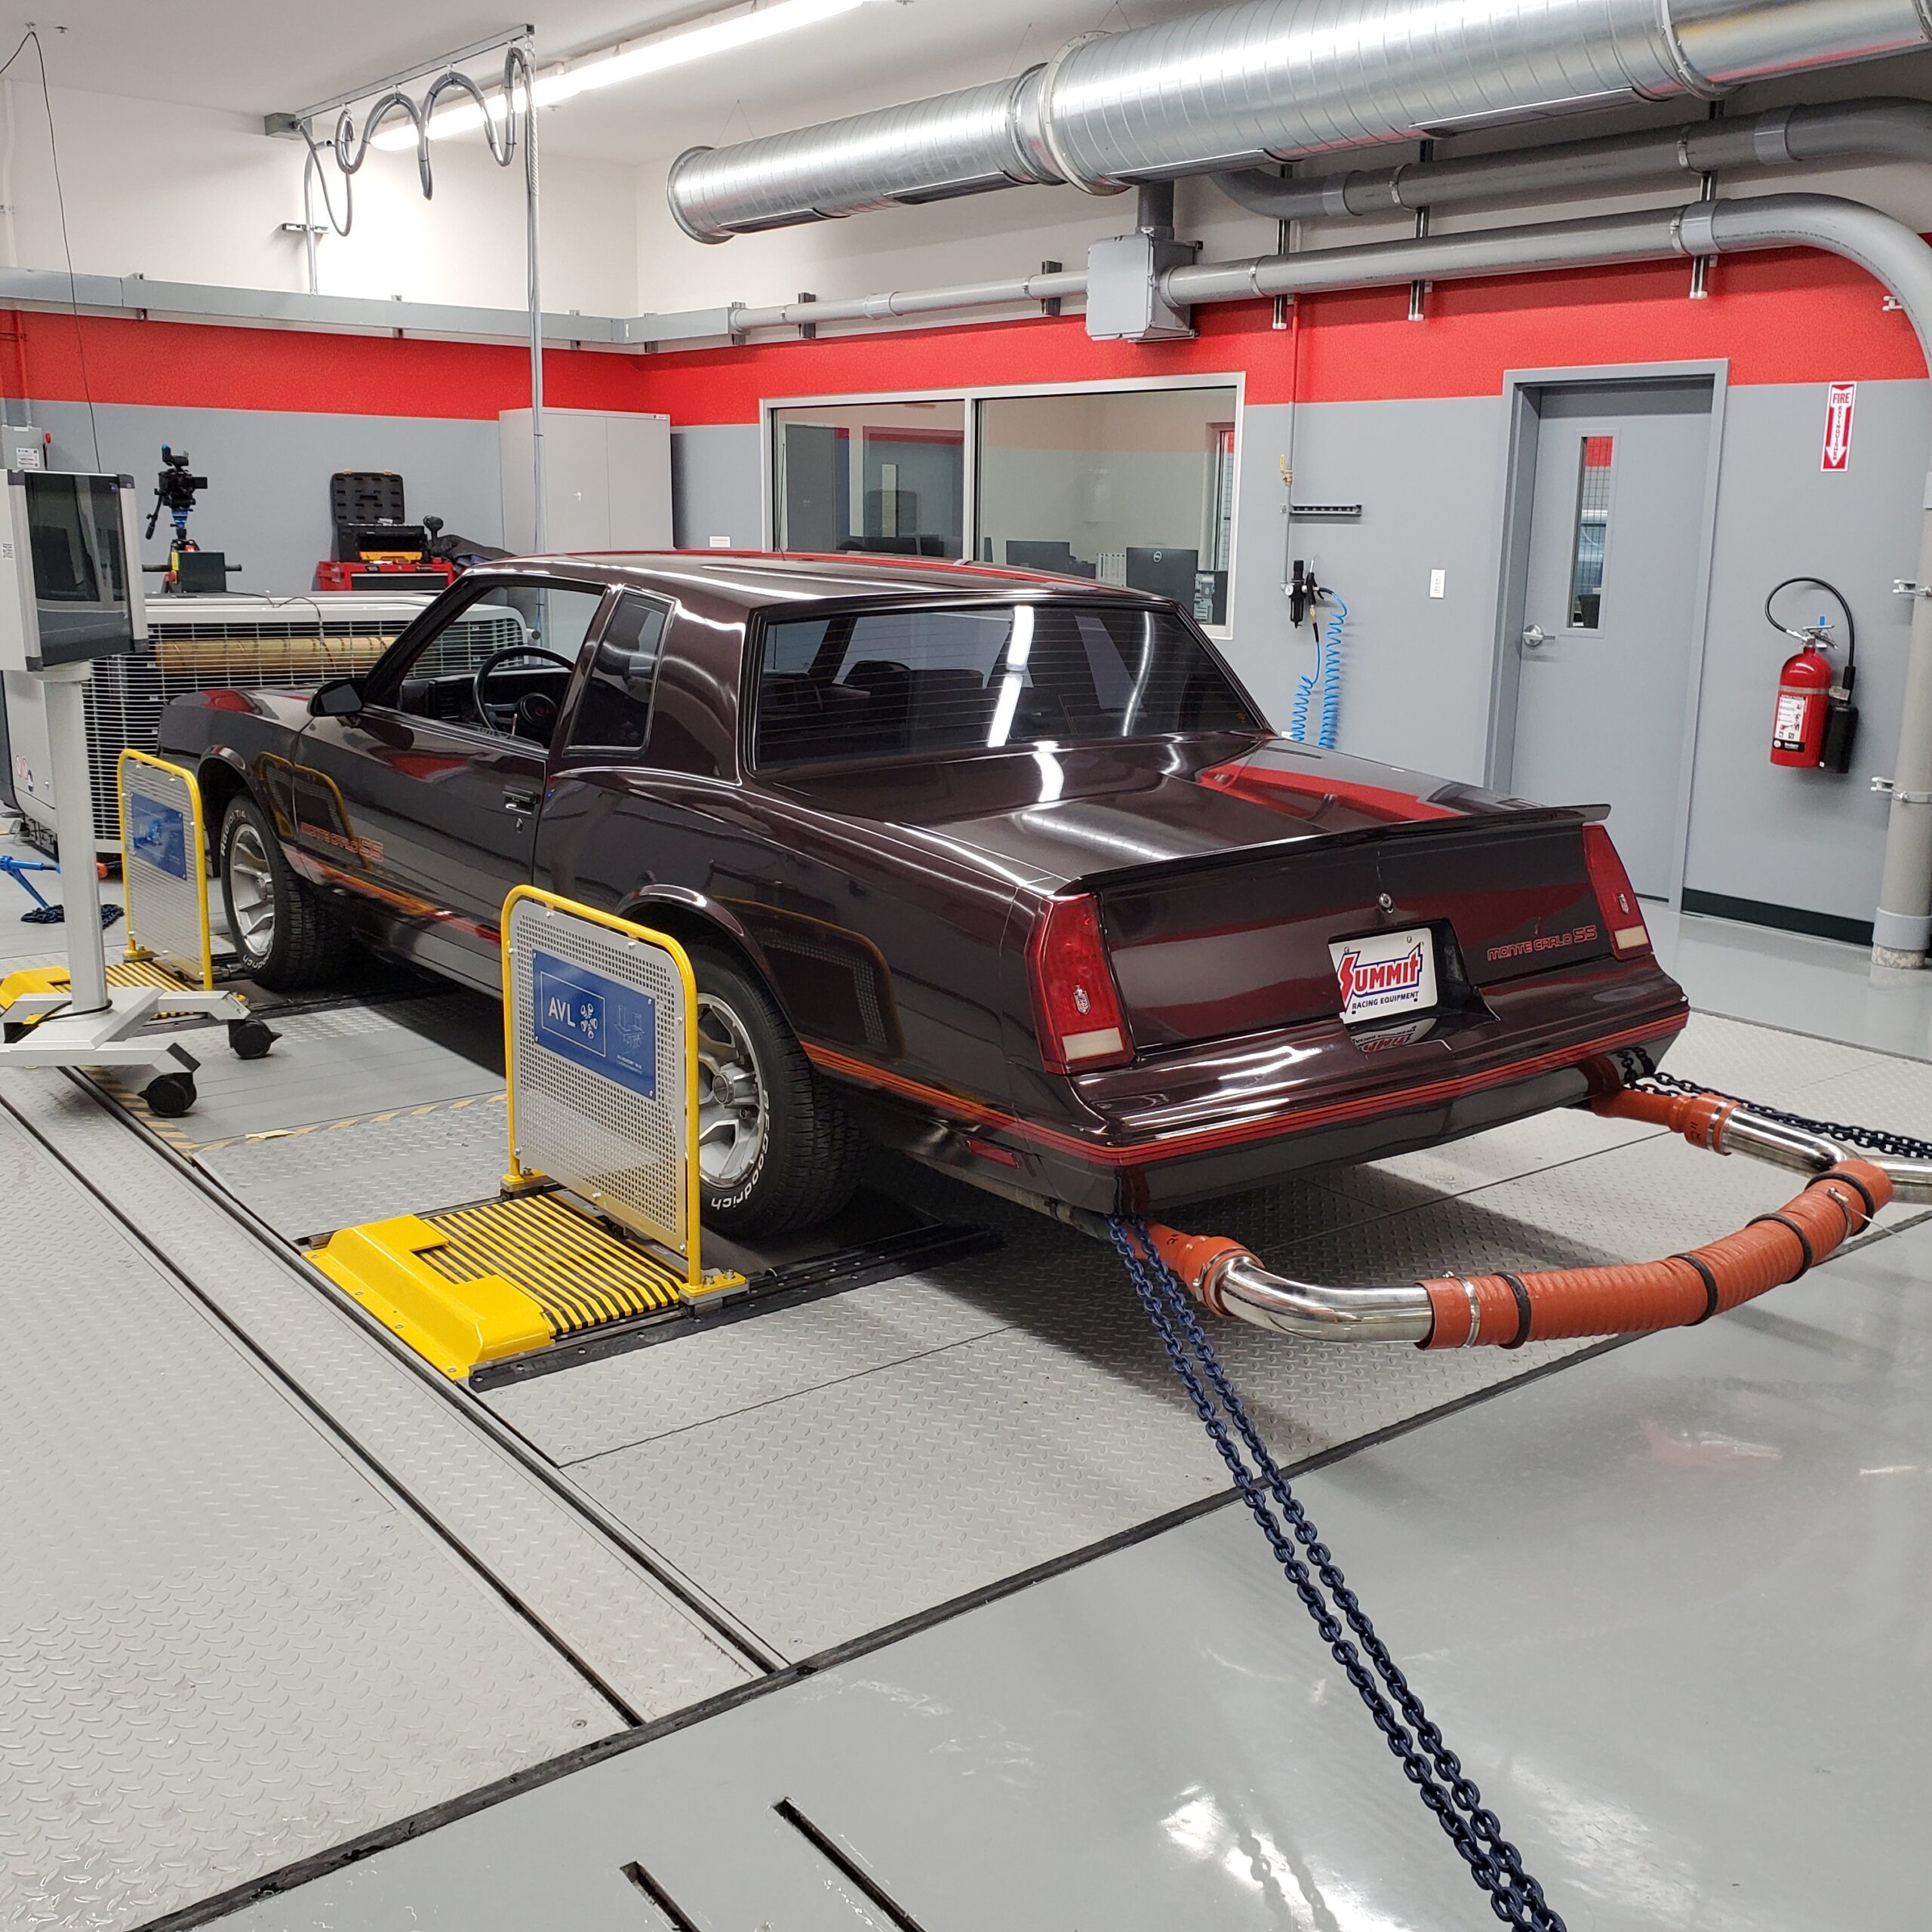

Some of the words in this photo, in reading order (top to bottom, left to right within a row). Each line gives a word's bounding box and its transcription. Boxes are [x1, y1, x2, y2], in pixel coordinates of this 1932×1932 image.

[1832, 392, 1850, 404] FIRE
[358, 835, 383, 863] SS
[1487, 940, 1533, 961] MONTE
[1533, 933, 1572, 951] CARLO
[1572, 924, 1598, 943] SS
[548, 996, 576, 1028] AVL
[1352, 998, 1379, 1010] RACING
[1380, 991, 1420, 1004] EQUIPMENT
